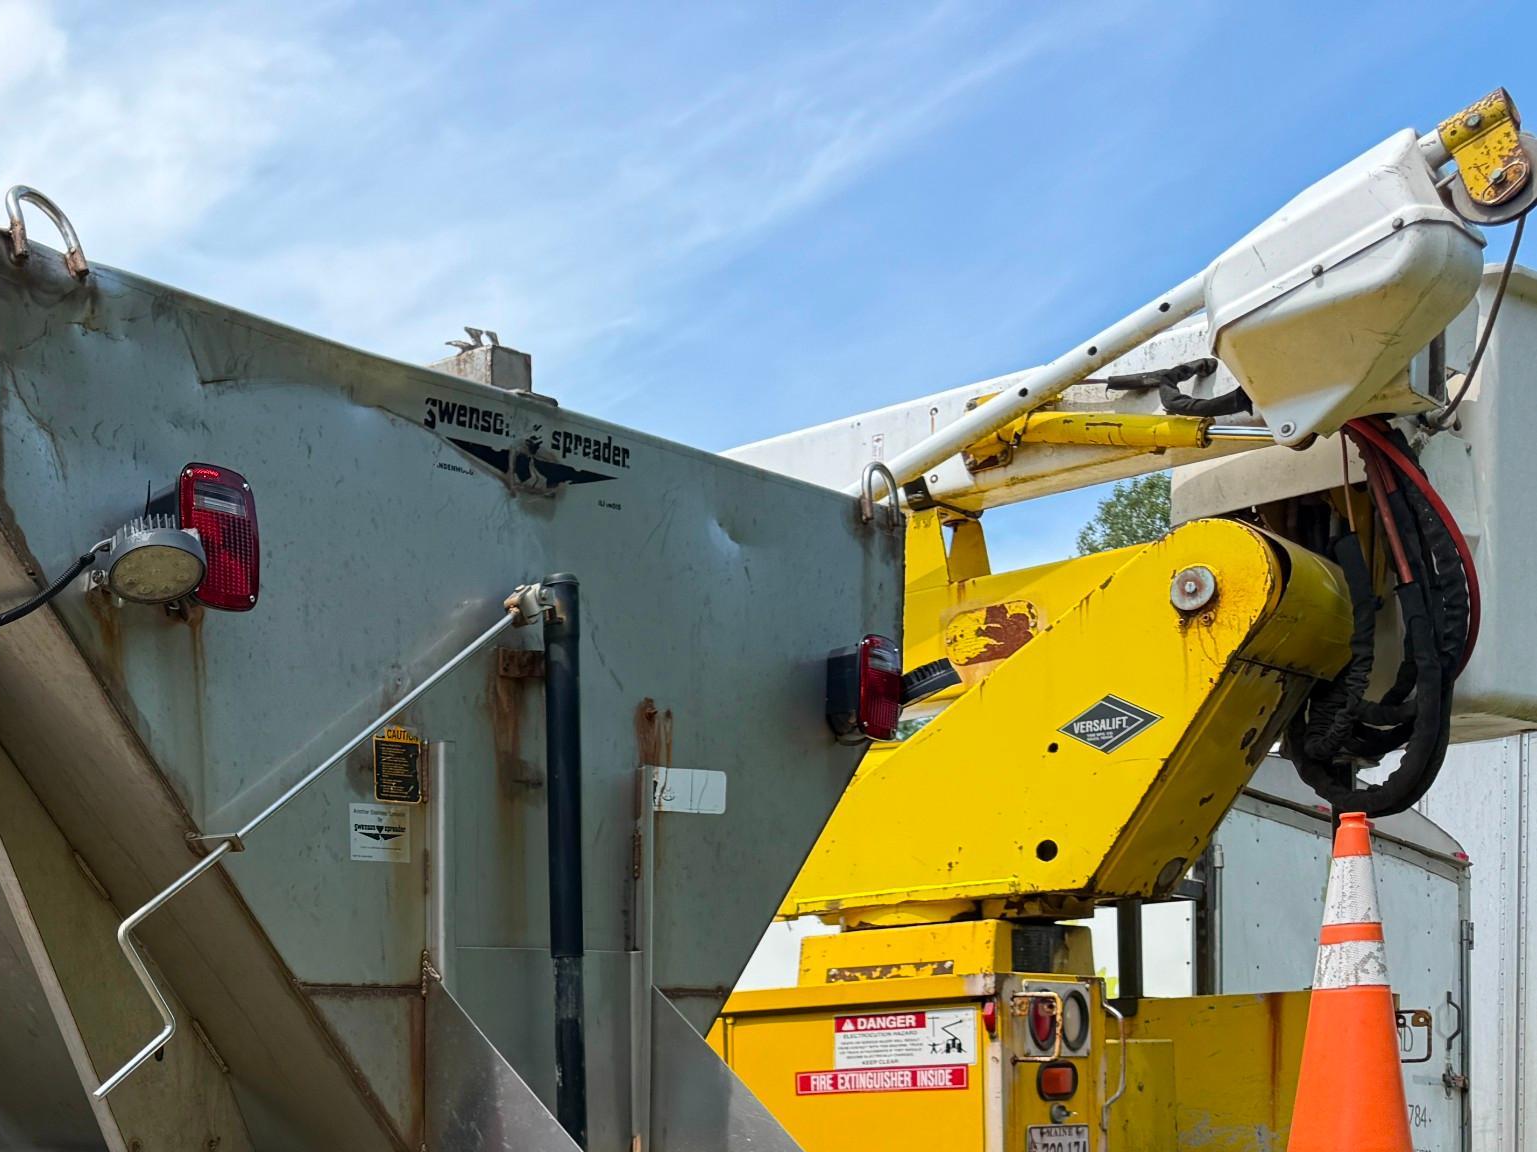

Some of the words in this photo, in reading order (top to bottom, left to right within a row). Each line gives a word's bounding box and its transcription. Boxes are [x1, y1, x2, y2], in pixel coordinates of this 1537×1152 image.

[424, 397, 516, 439] Swenso
[552, 430, 630, 468] spreader
[1073, 716, 1129, 734] VERSALIFT
[857, 1015, 917, 1030] DANGER
[810, 1075, 833, 1091] FIRE
[837, 1071, 912, 1090] EXTINGUISHER
[917, 1069, 953, 1088] INSIDE
